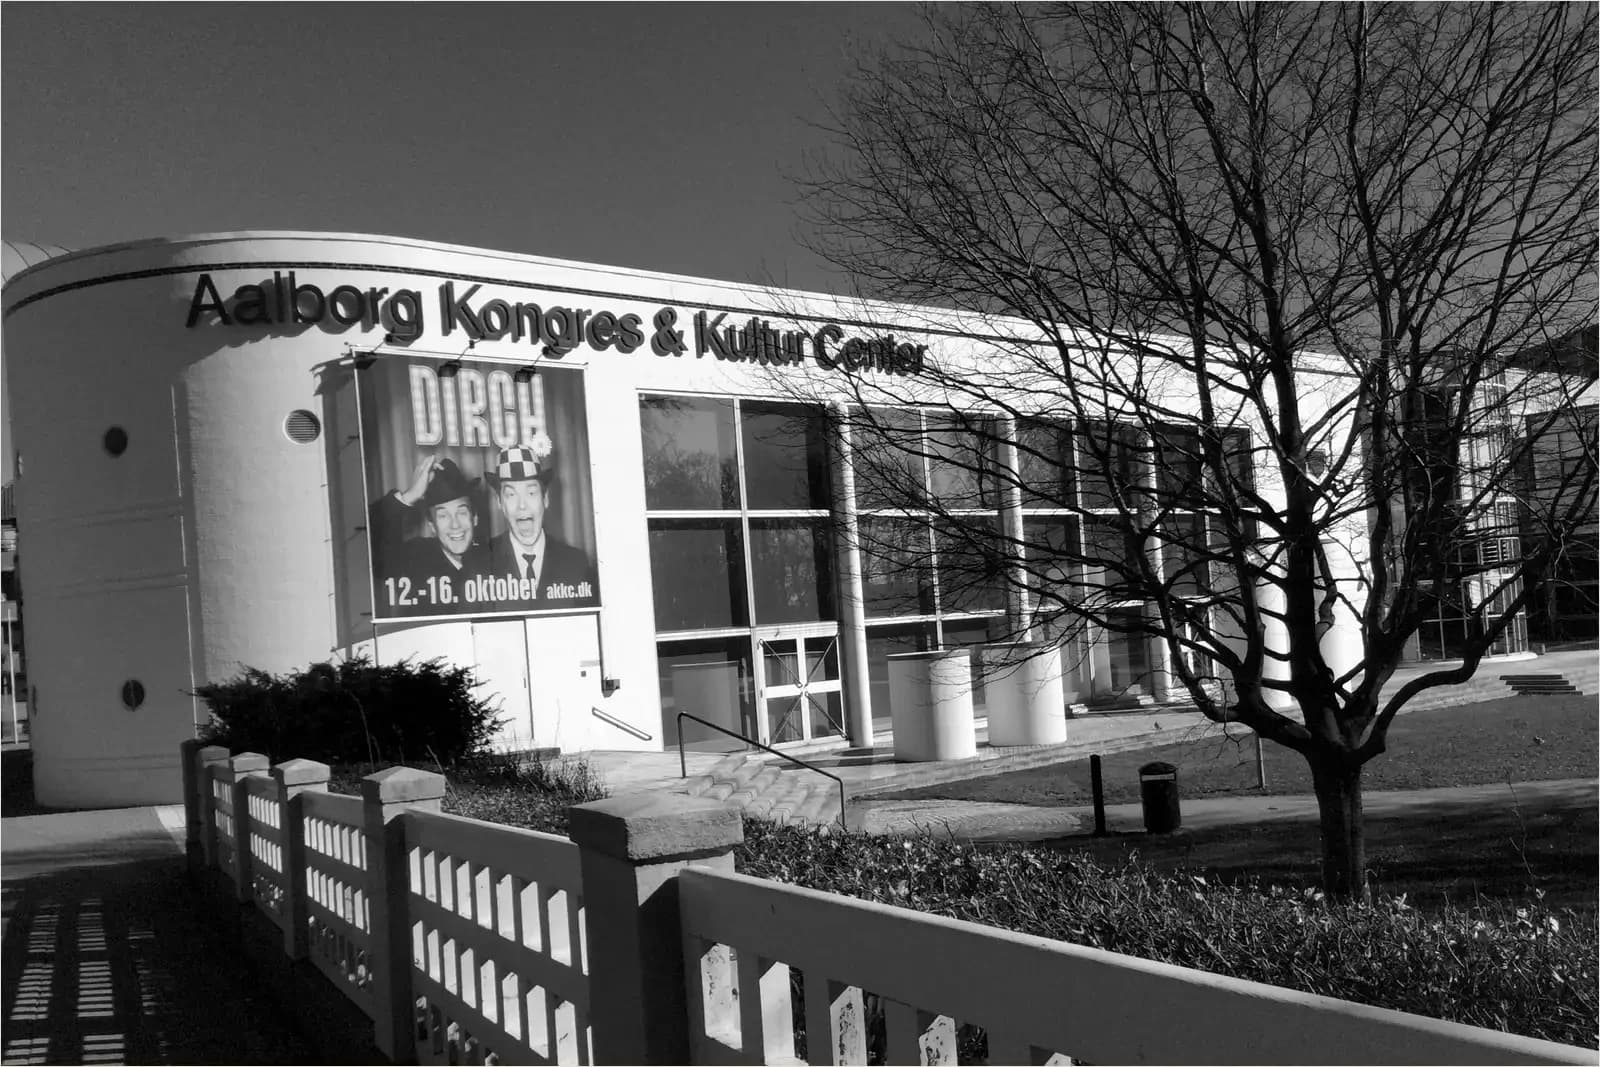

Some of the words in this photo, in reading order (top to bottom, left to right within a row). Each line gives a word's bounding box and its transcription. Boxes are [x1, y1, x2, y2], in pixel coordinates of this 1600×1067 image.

[186, 271, 423, 345] Aalborg
[439, 281, 643, 358] Kongres
[651, 307, 688, 356] &
[694, 311, 805, 365] Kultur
[813, 324, 928, 375] Center
[408, 364, 549, 449] DIRCH
[385, 575, 459, 606] 12.-16.
[464, 573, 537, 602] oktober
[546, 581, 593, 599] akkc.dk
